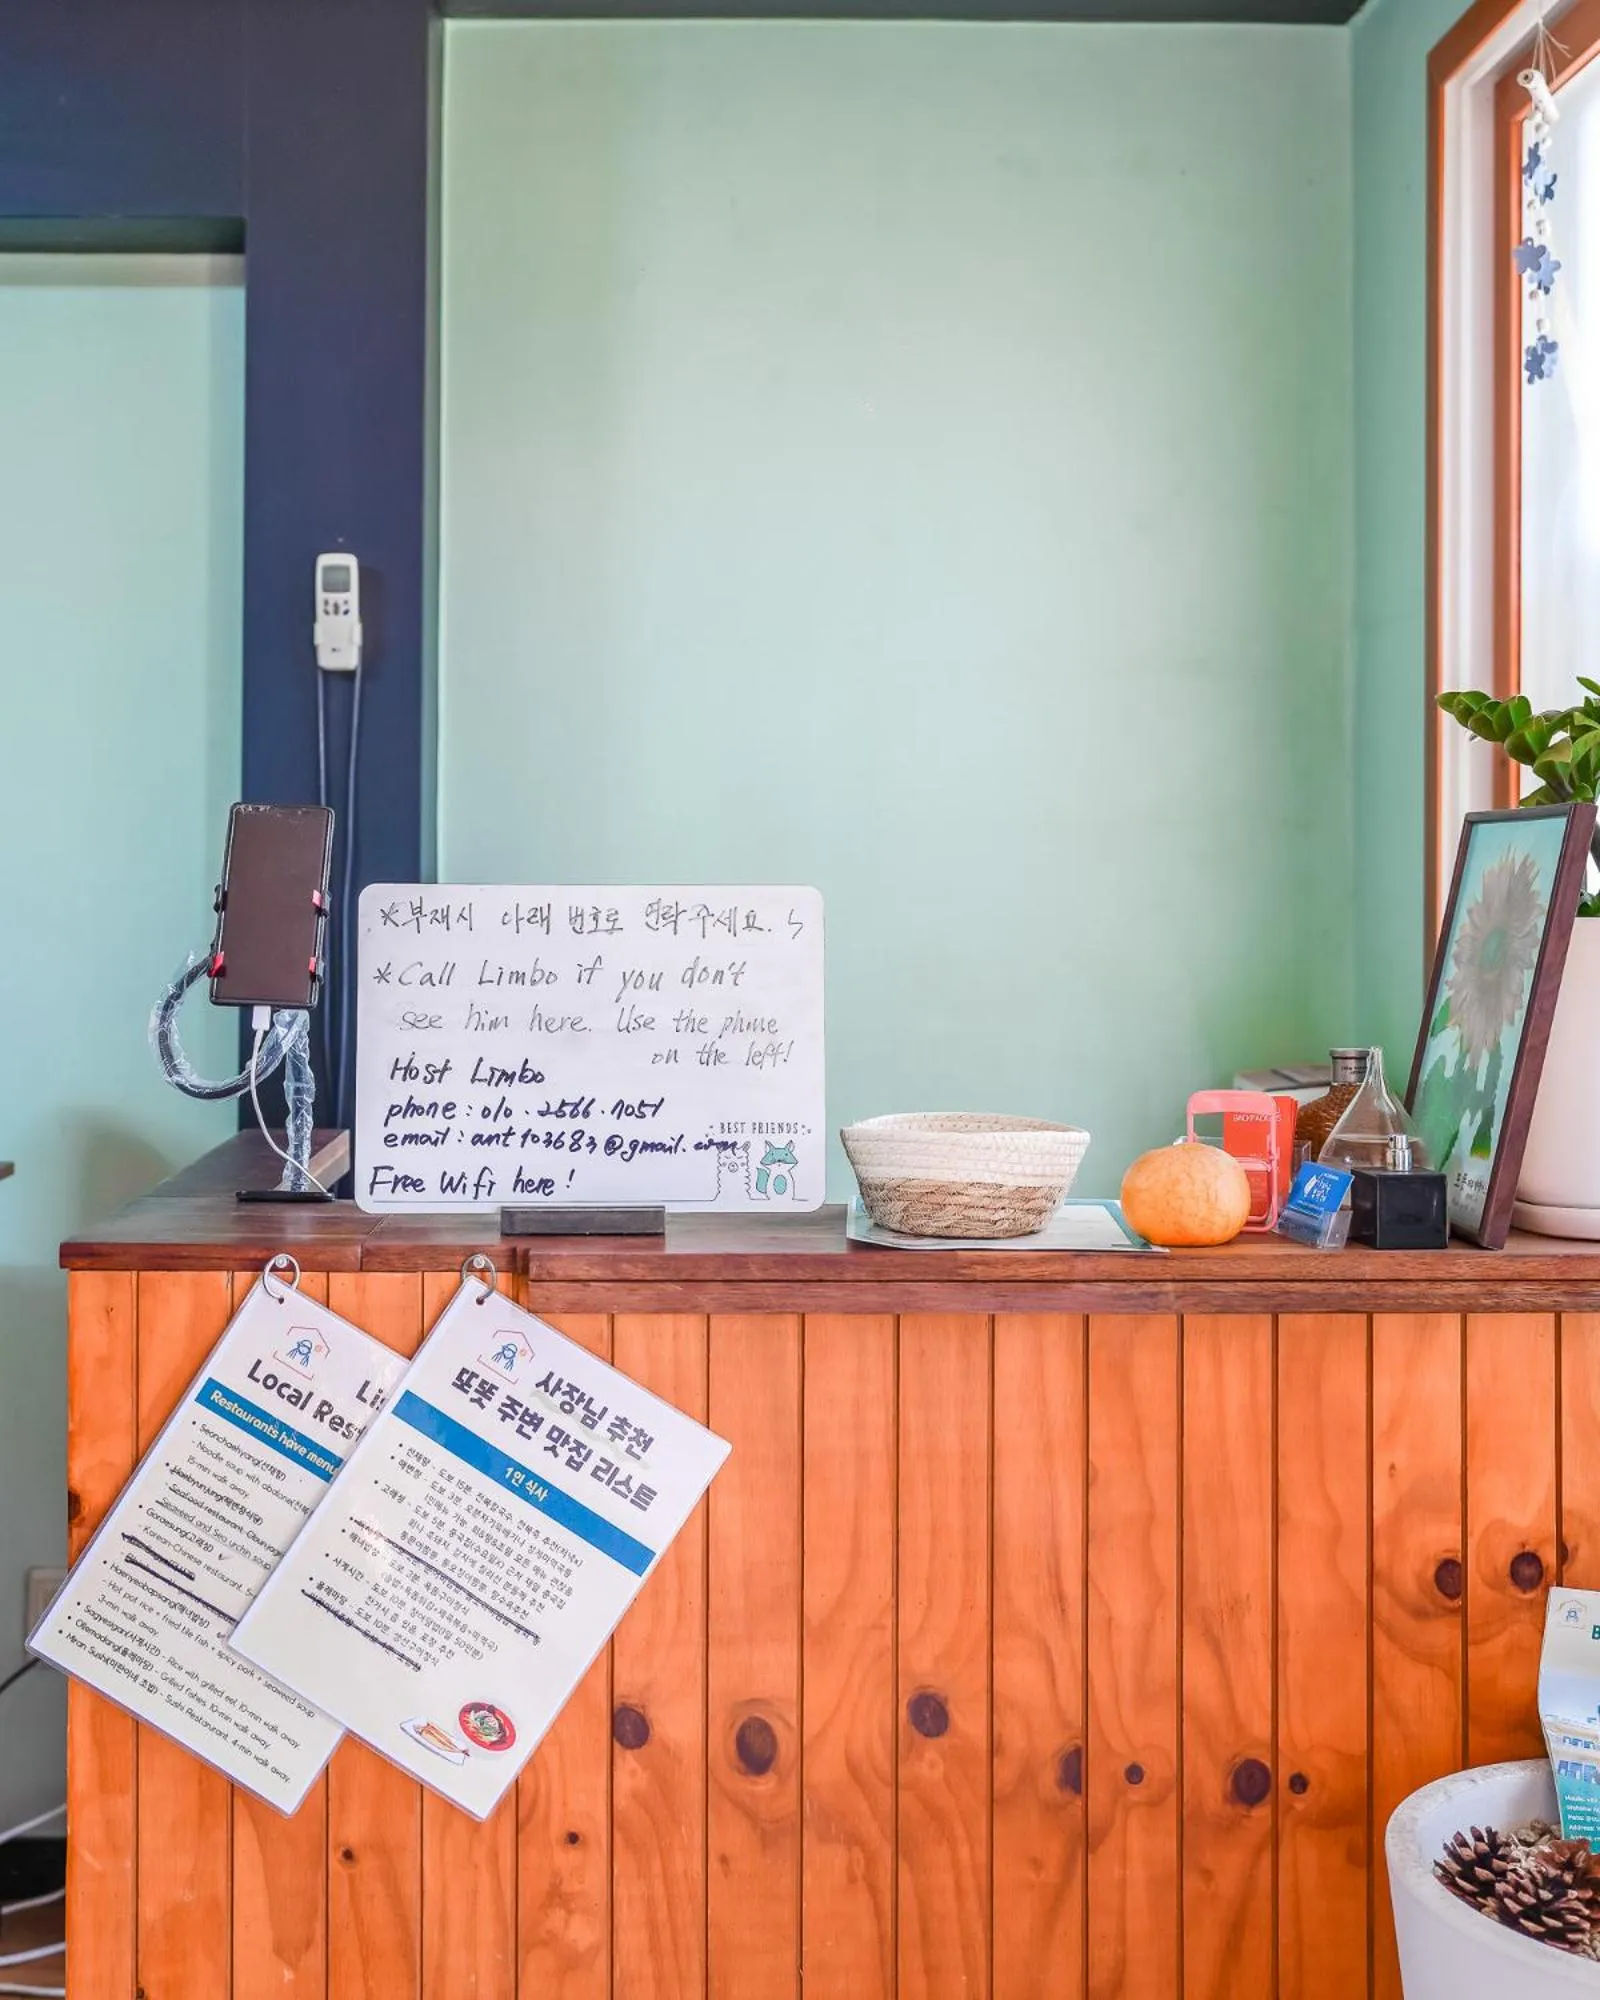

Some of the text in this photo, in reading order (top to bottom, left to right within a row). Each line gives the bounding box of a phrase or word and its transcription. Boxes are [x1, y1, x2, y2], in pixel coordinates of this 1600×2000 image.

[568, 906, 624, 934] 번호로
[478, 957, 558, 987] Limbo
[577, 955, 604, 985] if
[615, 969, 664, 1003] you
[681, 956, 747, 988] don't
[400, 1011, 443, 1031] see
[465, 1003, 509, 1032] him
[529, 1004, 592, 1033] here.
[616, 1004, 655, 1034] Use
[673, 1008, 709, 1033] the
[390, 1051, 546, 1088] Host Limbo
[651, 1040, 795, 1070] on the left!
[719, 1121, 799, 1135] BEST FRIENDS
[368, 1165, 426, 1196] Free
[440, 1165, 496, 1201] Wifi
[246, 1358, 314, 1411] Local
[354, 1379, 386, 1411] Li
[209, 1388, 279, 1439] Restaurants
[277, 1430, 307, 1456] have
[534, 1370, 654, 1461] 사장님 추천
[195, 1440, 224, 1462] Noodle
[224, 1460, 243, 1475] soup
[245, 1472, 260, 1485] with
[496, 1394, 545, 1440] 주변
[542, 1423, 593, 1472] 맛집
[589, 1456, 657, 1511] 리스트
[211, 1471, 228, 1484] walk
[429, 1480, 446, 1495] 도보
[437, 1467, 455, 1483] 도보
[504, 1466, 548, 1502] 1인 식사
[168, 1482, 205, 1509] Seafood
[159, 1496, 196, 1524] Seaweed
[194, 1519, 212, 1533] and
[212, 1528, 228, 1543] Sea
[228, 1539, 251, 1558] urchin
[142, 1525, 202, 1566] Korean-Chinese
[413, 1504, 430, 1519] 도보
[505, 1565, 524, 1581] 근처
[541, 1588, 566, 1610] 중국집
[332, 1557, 364, 1581] 사계시간
[370, 1581, 388, 1598] 도보
[389, 1559, 405, 1573] 도보
[512, 1553, 530, 1568] 모든
[531, 1564, 547, 1579] 메뉴
[120, 1609, 137, 1622] walk
[354, 1606, 372, 1622] 도보
[528, 1597, 545, 1613] 추천
[106, 1579, 123, 1594] Hot
[121, 1591, 138, 1603] pot
[138, 1600, 154, 1613] rice
[161, 1613, 182, 1630] fried
[193, 1633, 209, 1647] fish
[216, 1649, 237, 1666] spicy
[236, 1663, 255, 1678] pork
[263, 1680, 297, 1705] seaweed
[295, 1701, 315, 1718] soup
[419, 1632, 437, 1647] 포장
[437, 1644, 455, 1659] 추천
[65, 1632, 87, 1650] Miran
[164, 1693, 185, 1712] Sushi
[230, 1738, 252, 1756] 4-min
[252, 1754, 269, 1767] walk
[159, 1671, 185, 1691] Grilled
[208, 1702, 232, 1723] 10-min
[233, 1720, 249, 1733] walk
[166, 1655, 183, 1671] Rice
[183, 1666, 201, 1682] with
[199, 1679, 225, 1698] grilled
[237, 1702, 262, 1723] 10-min
[262, 1720, 278, 1735] walk
